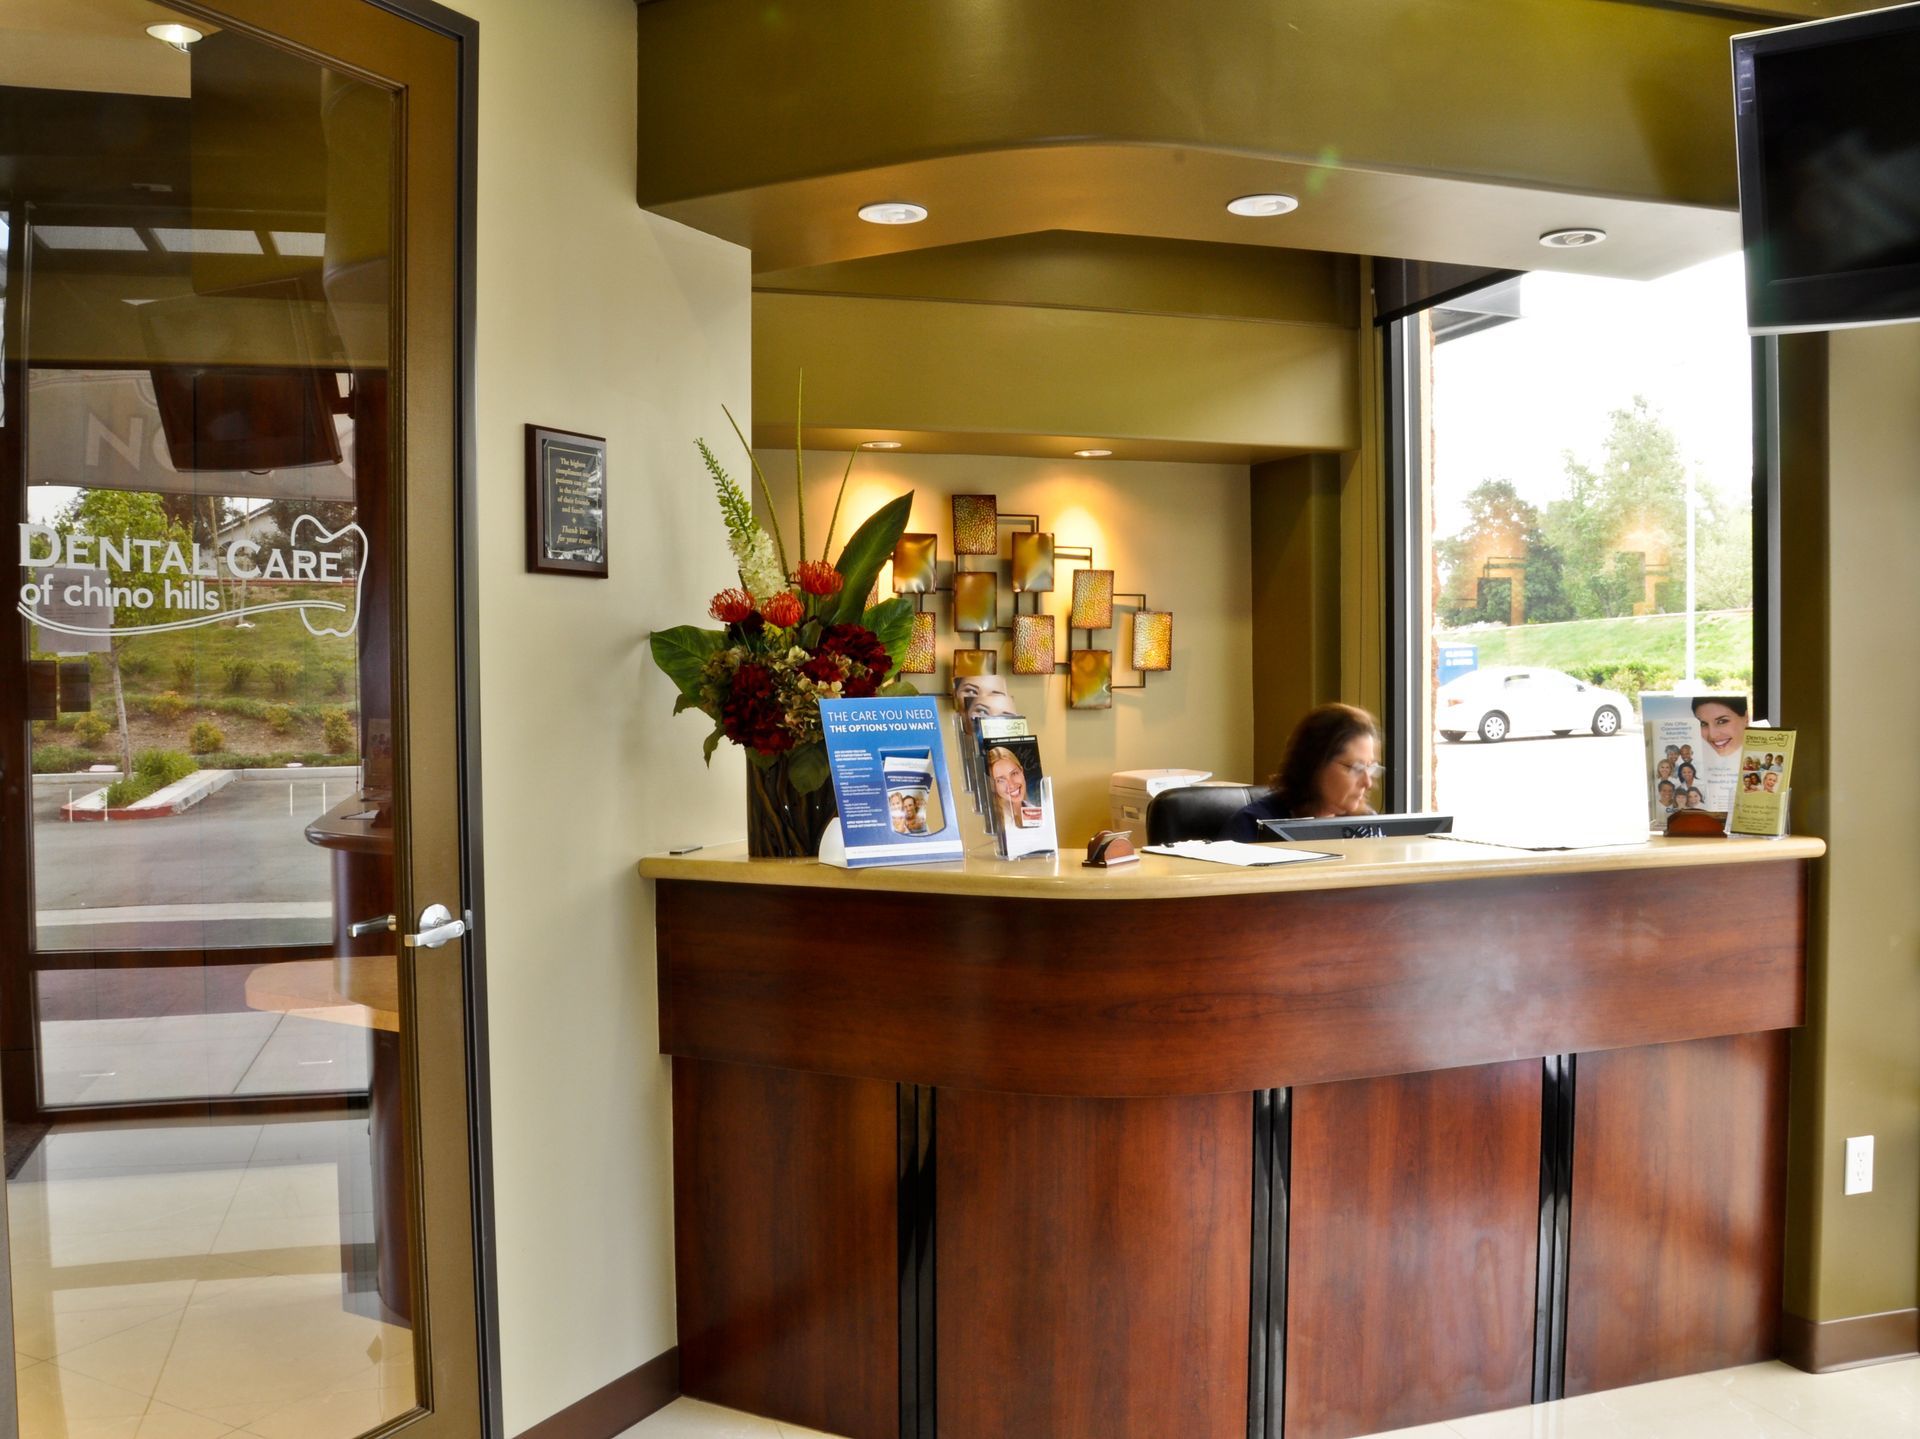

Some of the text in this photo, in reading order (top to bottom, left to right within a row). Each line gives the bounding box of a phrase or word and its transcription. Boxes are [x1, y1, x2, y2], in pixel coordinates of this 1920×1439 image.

[560, 458, 570, 466] The
[561, 525, 578, 535] Thank
[18, 523, 343, 583] DENTAL CARE
[20, 574, 220, 610] of chino hills
[828, 709, 935, 722] THE CARE YOU NEED.
[830, 722, 937, 734] THE OPTIONS YOU WANT.
